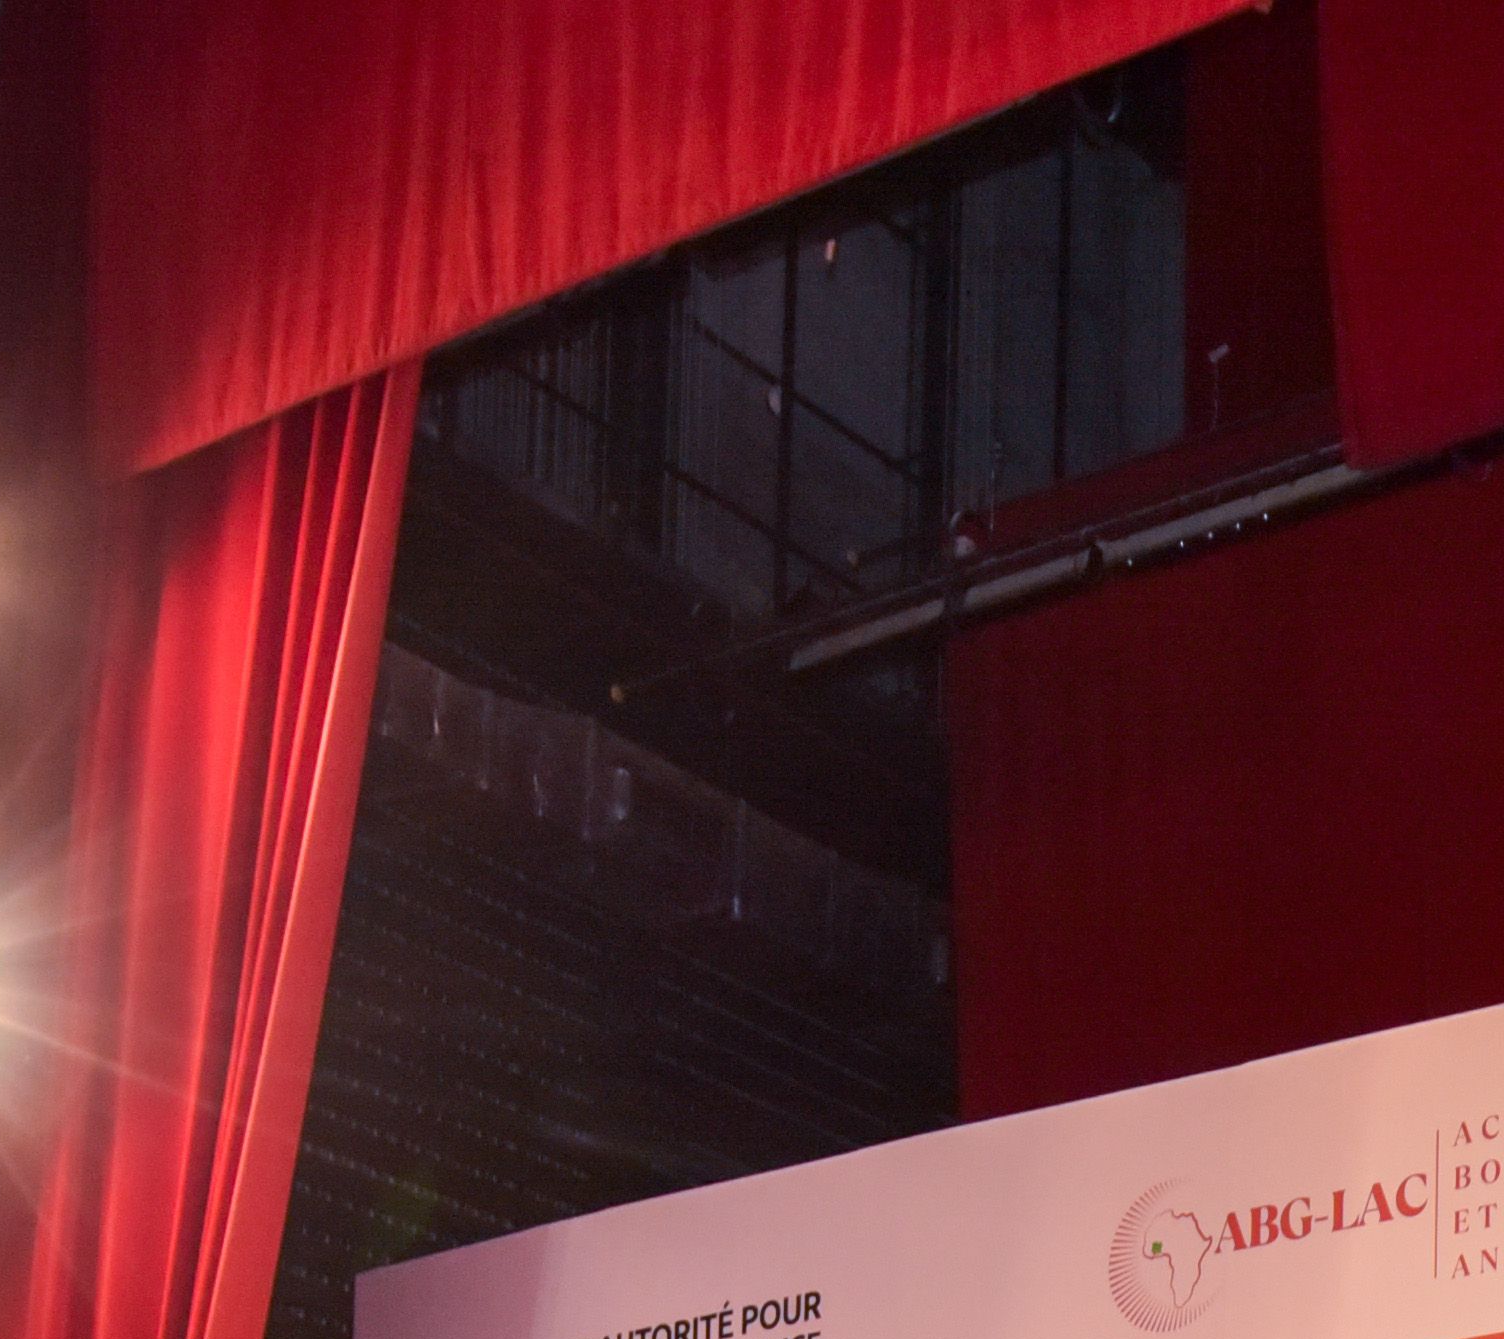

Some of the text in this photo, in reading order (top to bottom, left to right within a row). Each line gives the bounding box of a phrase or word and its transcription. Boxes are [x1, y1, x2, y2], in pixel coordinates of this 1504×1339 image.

[1215, 1174, 1427, 1254] ABG-LAC
[1455, 1203, 1497, 1234] ET
[742, 1292, 821, 1334] POUR
